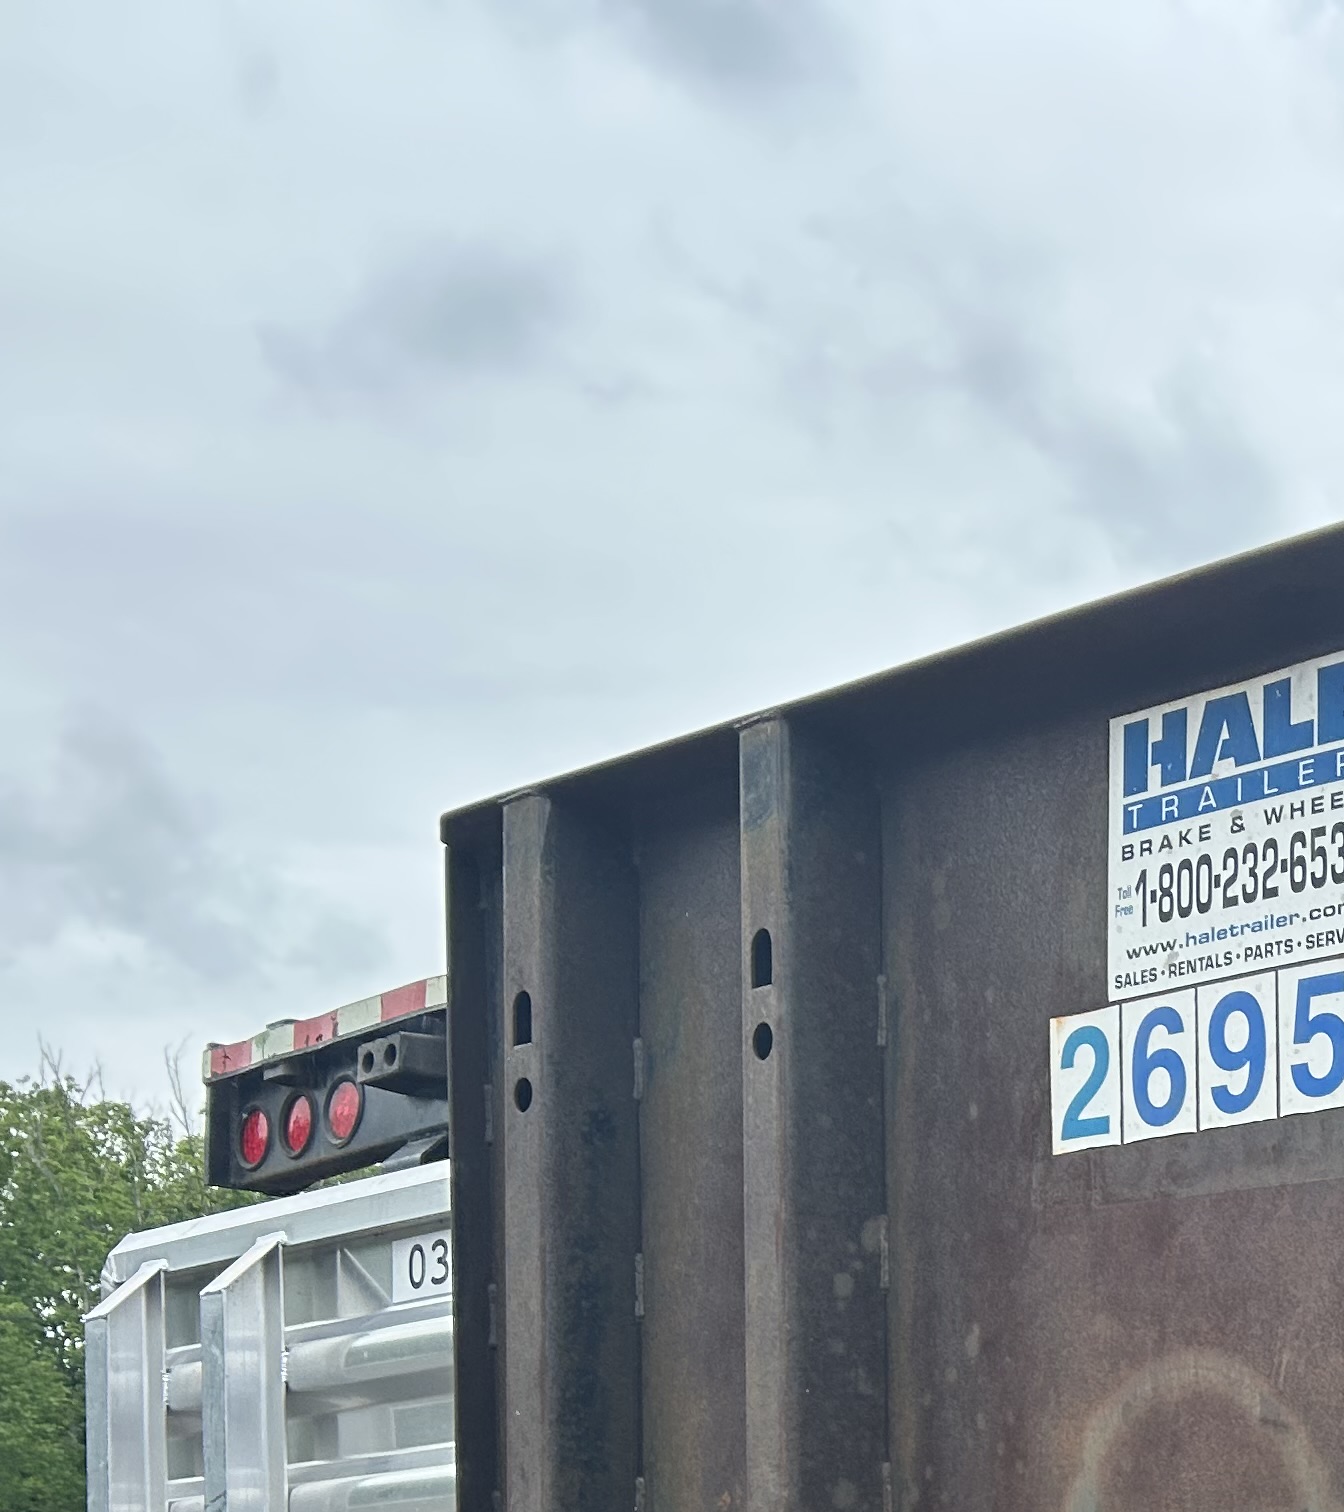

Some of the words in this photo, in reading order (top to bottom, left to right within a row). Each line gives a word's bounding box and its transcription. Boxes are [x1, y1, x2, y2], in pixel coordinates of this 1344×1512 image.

[1121, 823, 1211, 862] BRAKE
[1230, 815, 1246, 834] &
[1115, 904, 1134, 919] Free
